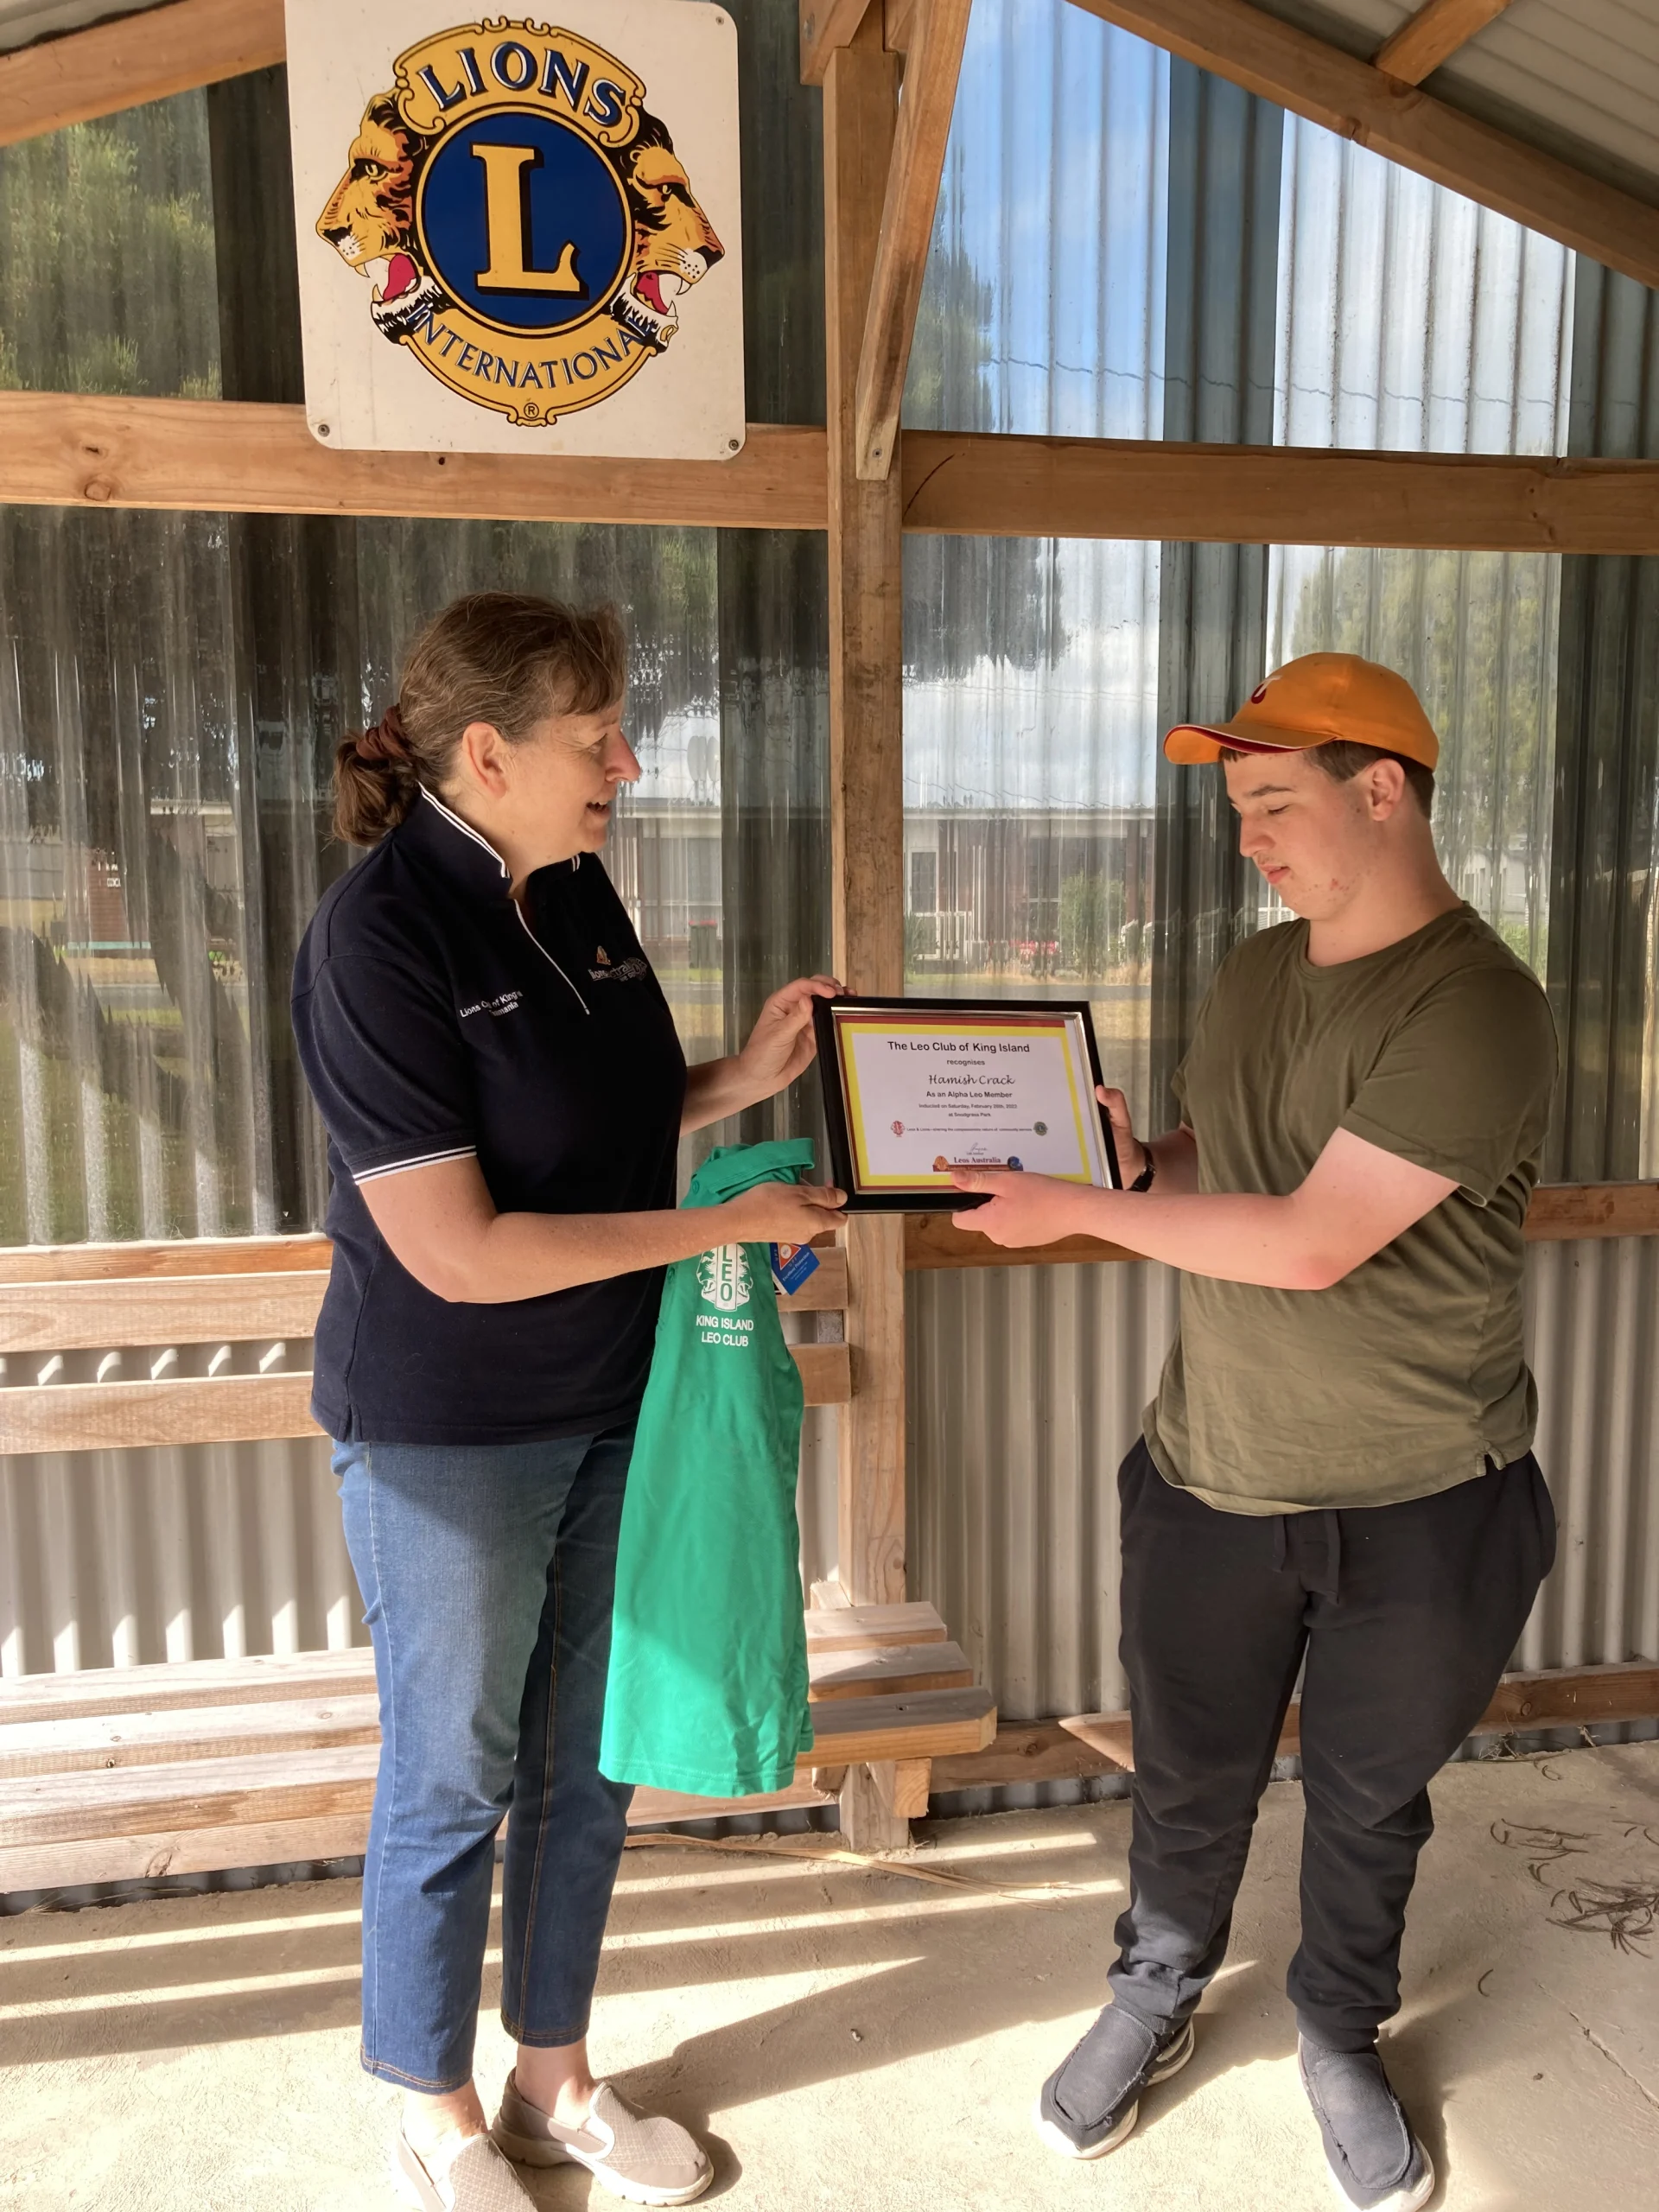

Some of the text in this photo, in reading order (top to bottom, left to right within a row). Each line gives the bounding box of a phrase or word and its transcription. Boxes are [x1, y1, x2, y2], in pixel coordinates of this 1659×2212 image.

[417, 41, 626, 127] LIONS
[470, 143, 589, 299] L
[406, 302, 657, 389] INTERNATIONAL
[460, 1004, 481, 1018] Lions
[492, 998, 500, 1007] of
[499, 991, 518, 1004] King
[887, 1041, 1030, 1053] The Leo Club of King Island
[929, 1074, 1015, 1085] Hamish Crack
[696, 1315, 753, 1332] KING ISLAND
[701, 1332, 749, 1347] LEO CLUB
